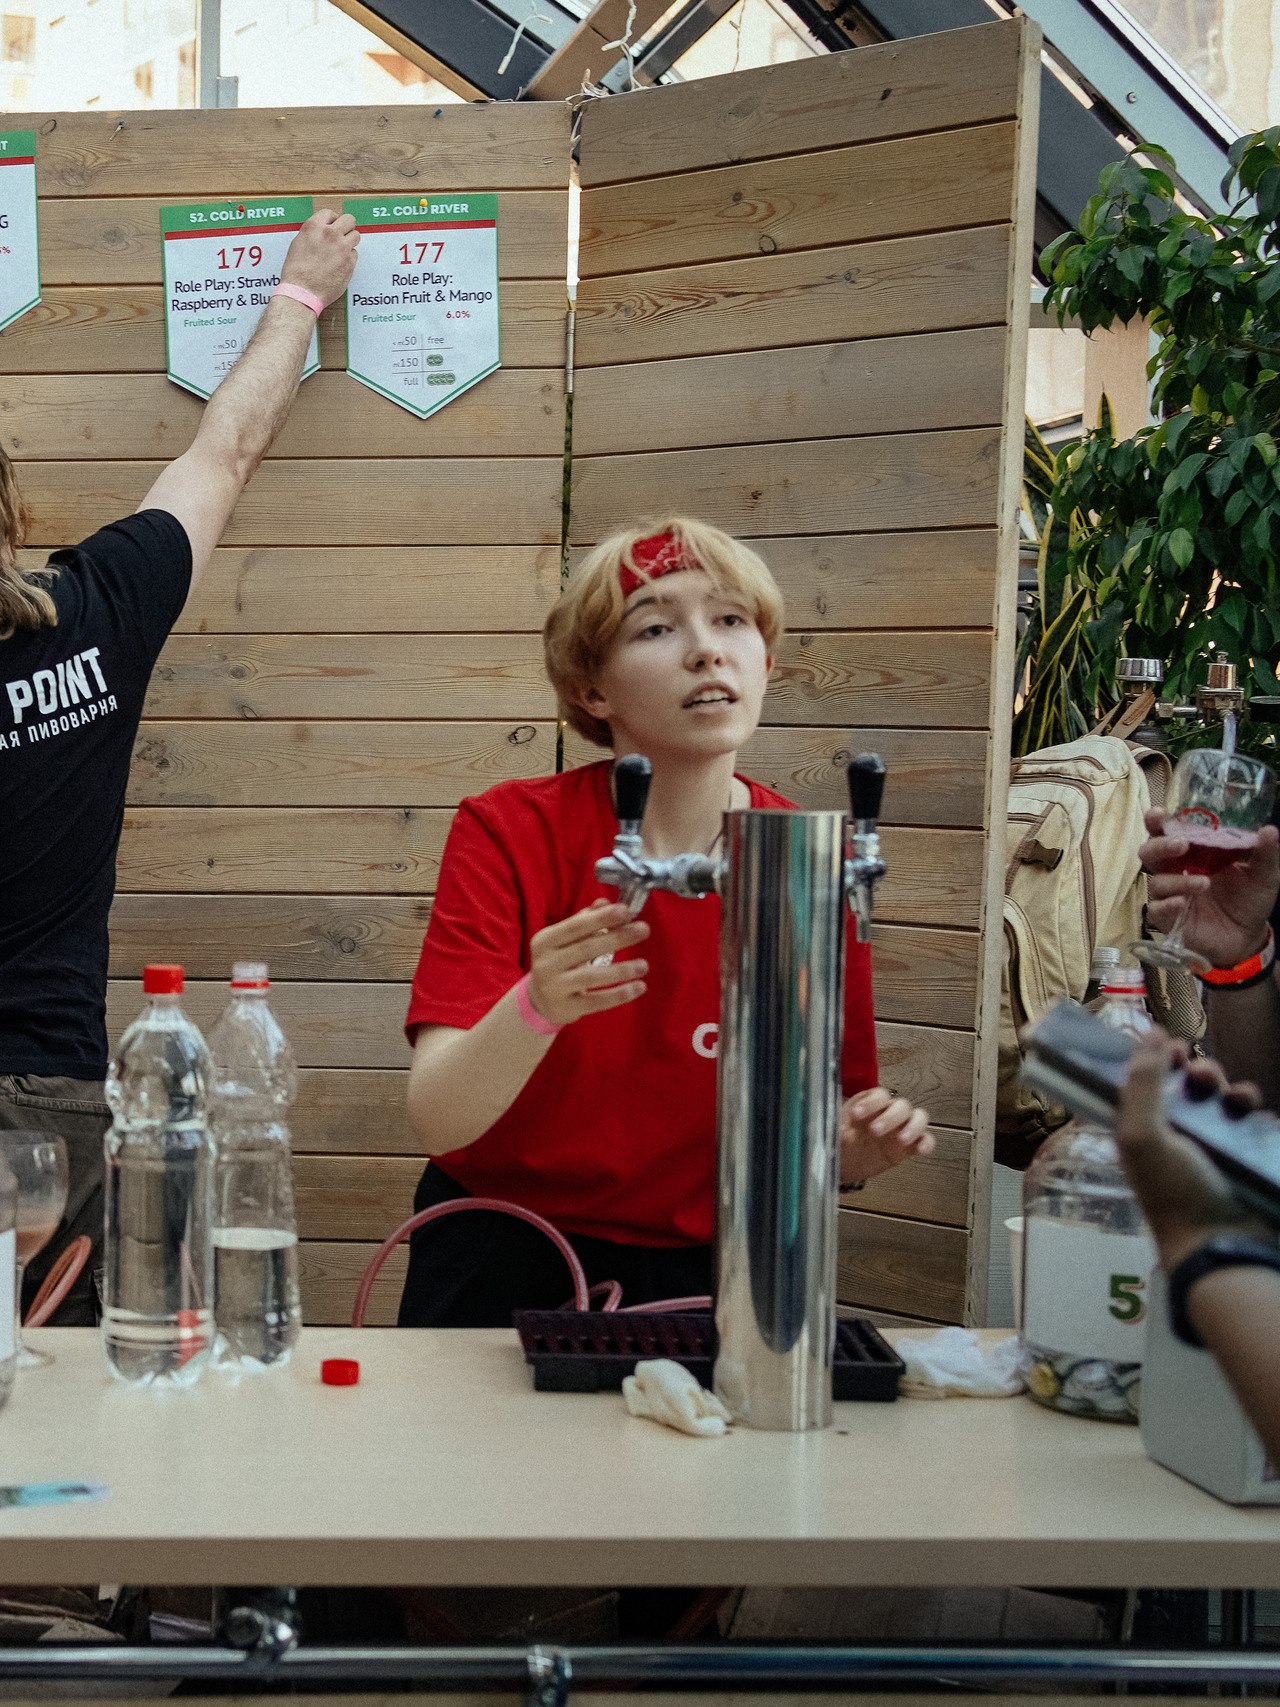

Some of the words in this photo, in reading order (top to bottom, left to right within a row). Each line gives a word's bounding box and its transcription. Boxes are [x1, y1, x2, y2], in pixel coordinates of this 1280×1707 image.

[189, 212, 208, 223] 52.
[210, 209, 245, 222] COLD
[247, 207, 285, 219] RIVER
[372, 207, 391, 217] 52.
[392, 204, 428, 216] COLD
[430, 203, 469, 215] RIVER
[216, 245, 263, 270] 179
[399, 242, 445, 265] 177
[174, 280, 202, 293] Role
[204, 278, 235, 294] Play:
[237, 274, 281, 290] Strawb
[391, 273, 420, 286] Role
[422, 272, 453, 287] Play:
[171, 296, 234, 314] Raspberry
[236, 294, 248, 307] &
[352, 292, 400, 307] Passion
[402, 290, 431, 305] Fruit
[434, 289, 446, 302] &
[449, 289, 493, 304] Mango
[184, 317, 215, 327] Fruited
[217, 316, 237, 326] Sour
[362, 314, 394, 323] Fruited
[395, 312, 417, 322] Sour
[445, 310, 471, 319] 6.0%
[427, 336, 445, 344] free
[403, 377, 419, 386] full
[6, 647, 108, 724] POINT
[28, 694, 119, 743] ПИВОВАРНЯ
